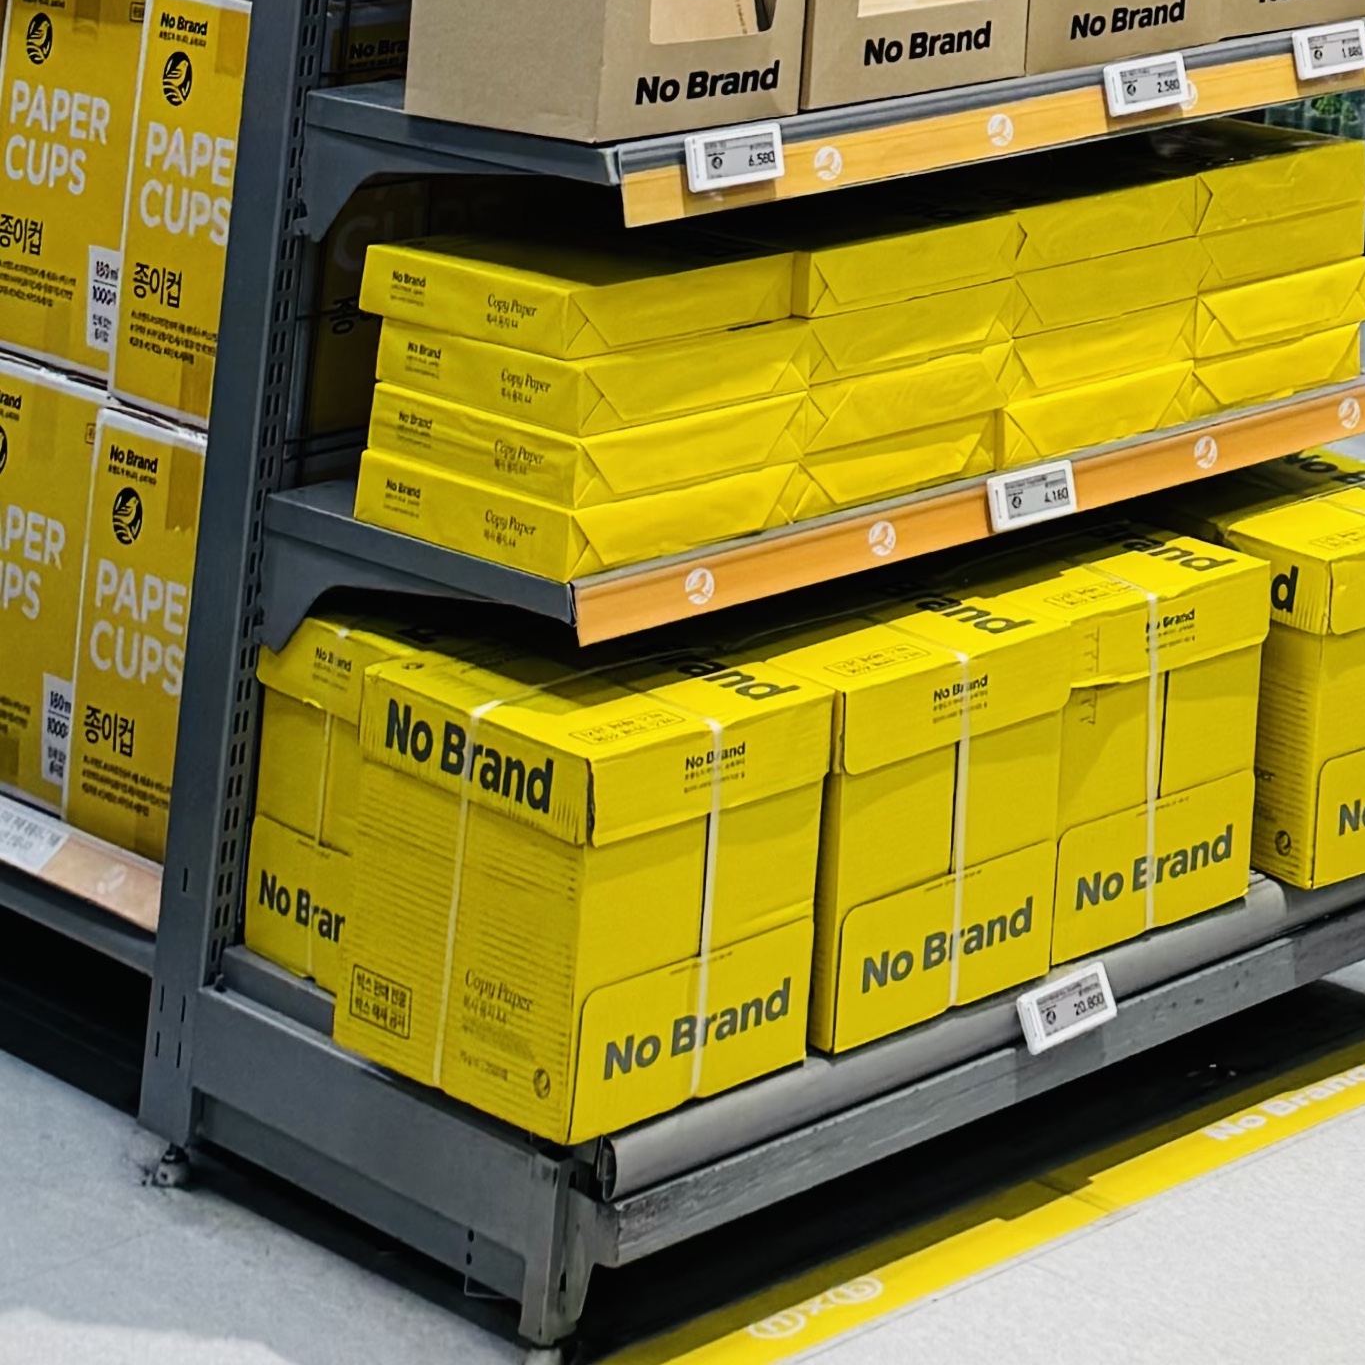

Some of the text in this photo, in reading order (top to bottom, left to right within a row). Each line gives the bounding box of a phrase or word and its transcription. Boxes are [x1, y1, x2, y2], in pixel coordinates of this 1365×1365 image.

[161, 12, 208, 36] No Brand
[864, 21, 991, 66] No Brand
[1070, 14, 1106, 39] No
[636, 61, 779, 104] No Brand
[10, 80, 110, 144] PAPER
[5, 135, 86, 195] CUPS
[145, 122, 234, 184] PAPE
[0, 215, 43, 256] 종이컵
[139, 179, 231, 246] CUPS
[133, 263, 182, 307] 종이컵
[487, 294, 536, 317] Copy Paper
[501, 369, 550, 392] Copy Paper
[110, 444, 158, 474] No Brand
[485, 510, 536, 535] Copy Paper
[95, 560, 184, 635] PAPE
[90, 622, 184, 696] CUPS
[83, 706, 135, 758] 종이컵
[386, 699, 554, 814] No Brand
[1076, 826, 1233, 911] No Brand
[260, 870, 289, 916] No
[861, 897, 1033, 993] No Brand
[466, 970, 493, 994] Copy
[603, 1035, 660, 1080] No
[671, 978, 792, 1055] Brand
